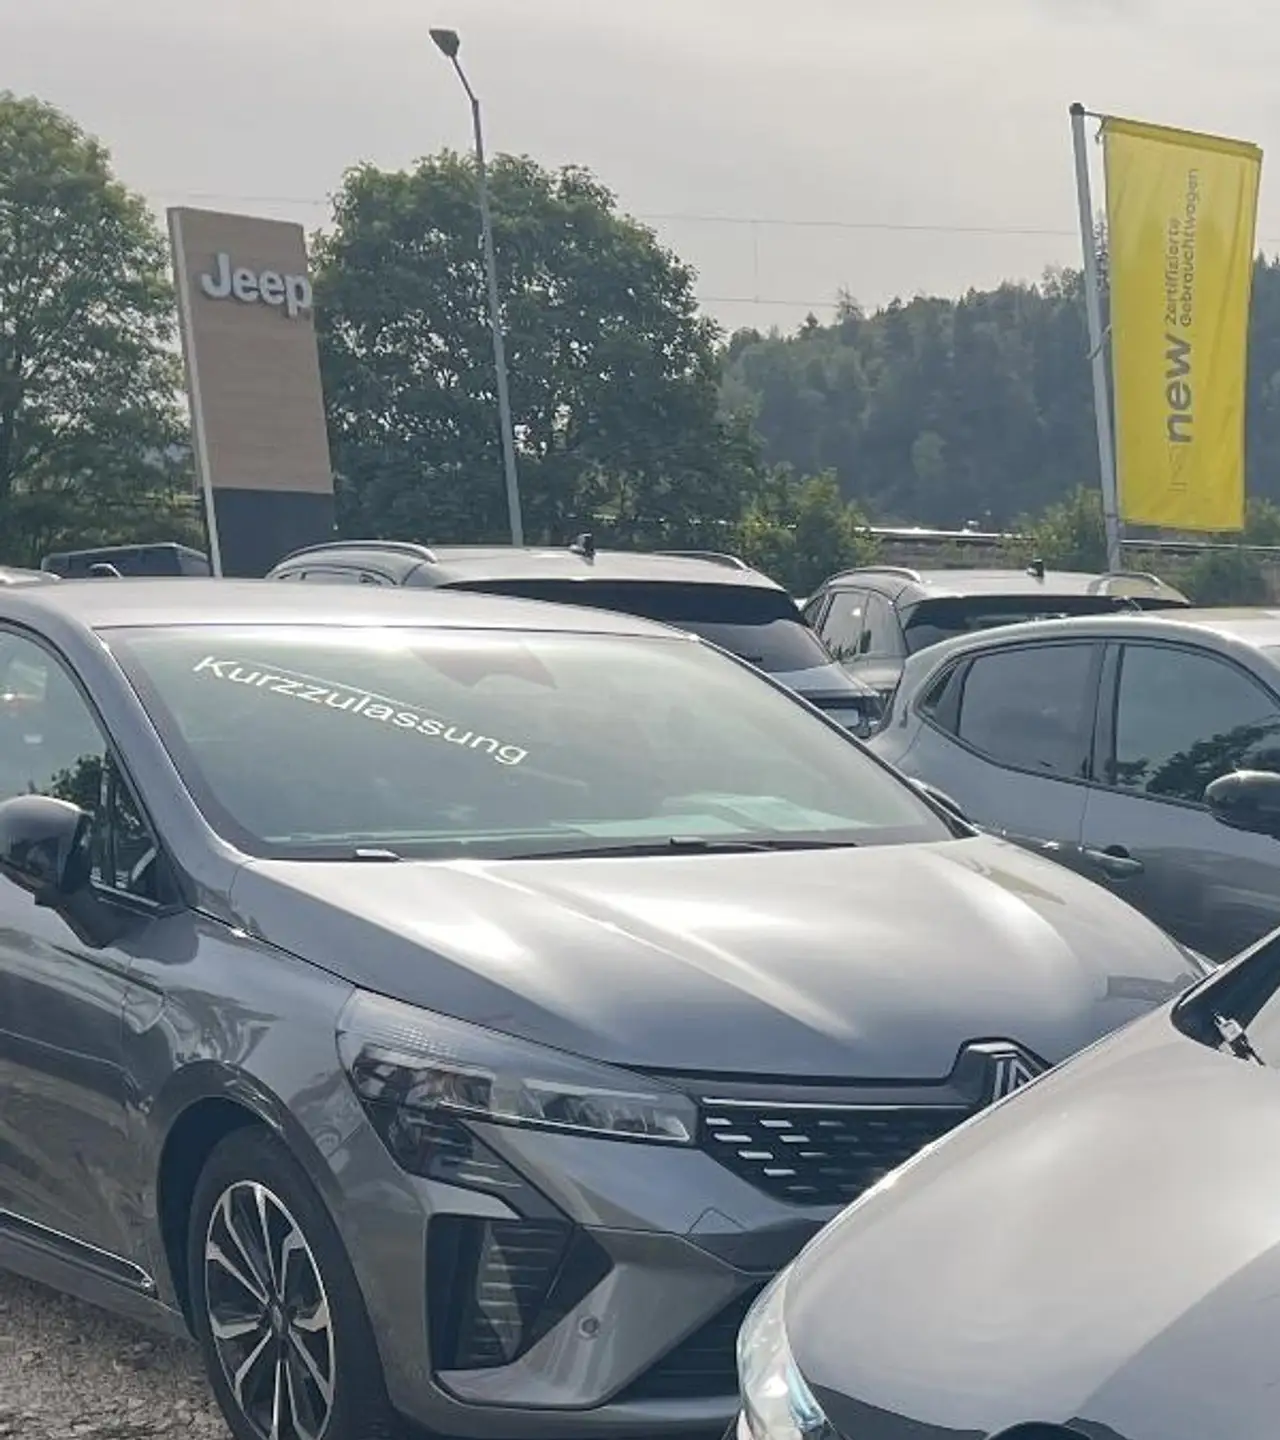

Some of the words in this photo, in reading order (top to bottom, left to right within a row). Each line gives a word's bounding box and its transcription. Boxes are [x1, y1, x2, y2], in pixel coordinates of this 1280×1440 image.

[201, 252, 312, 317] Jeep
[1165, 218, 1183, 326] Zertifizierte
[1180, 168, 1200, 328] Gebrauchtwagen
[192, 654, 530, 766] Kurzzulassung
